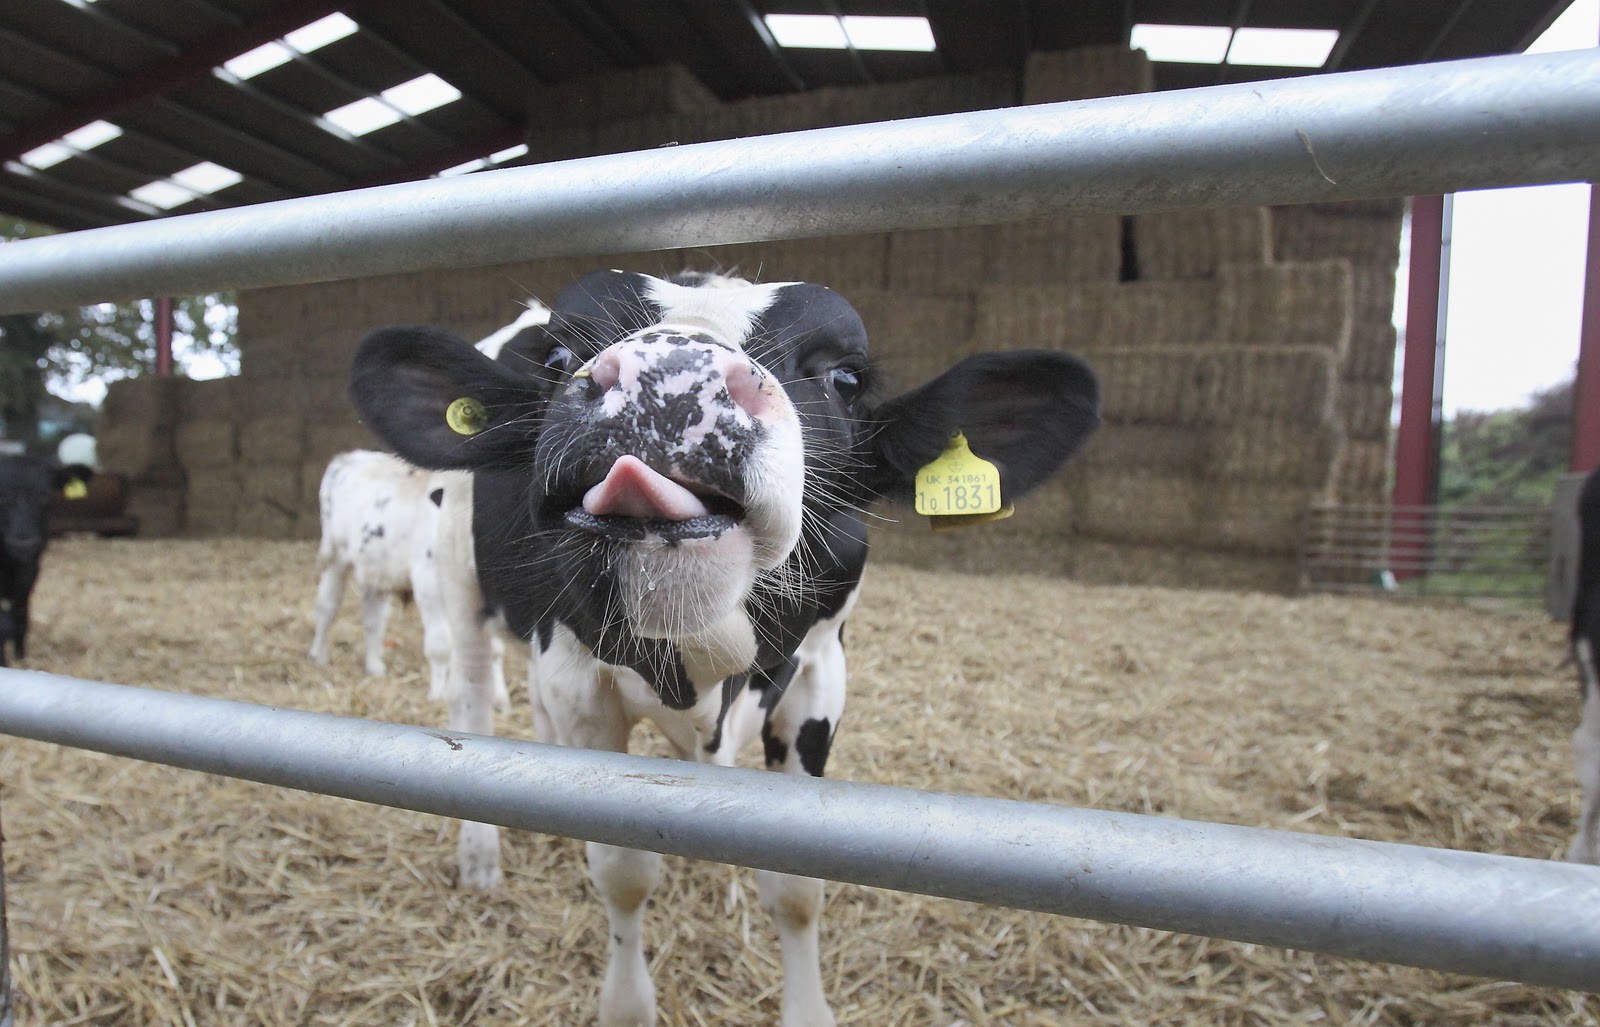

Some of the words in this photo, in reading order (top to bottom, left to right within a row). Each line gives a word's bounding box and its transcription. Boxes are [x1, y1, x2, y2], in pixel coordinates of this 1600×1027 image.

[926, 475, 941, 484] UK
[947, 474, 986, 484] 341861
[943, 484, 995, 511] 1831
